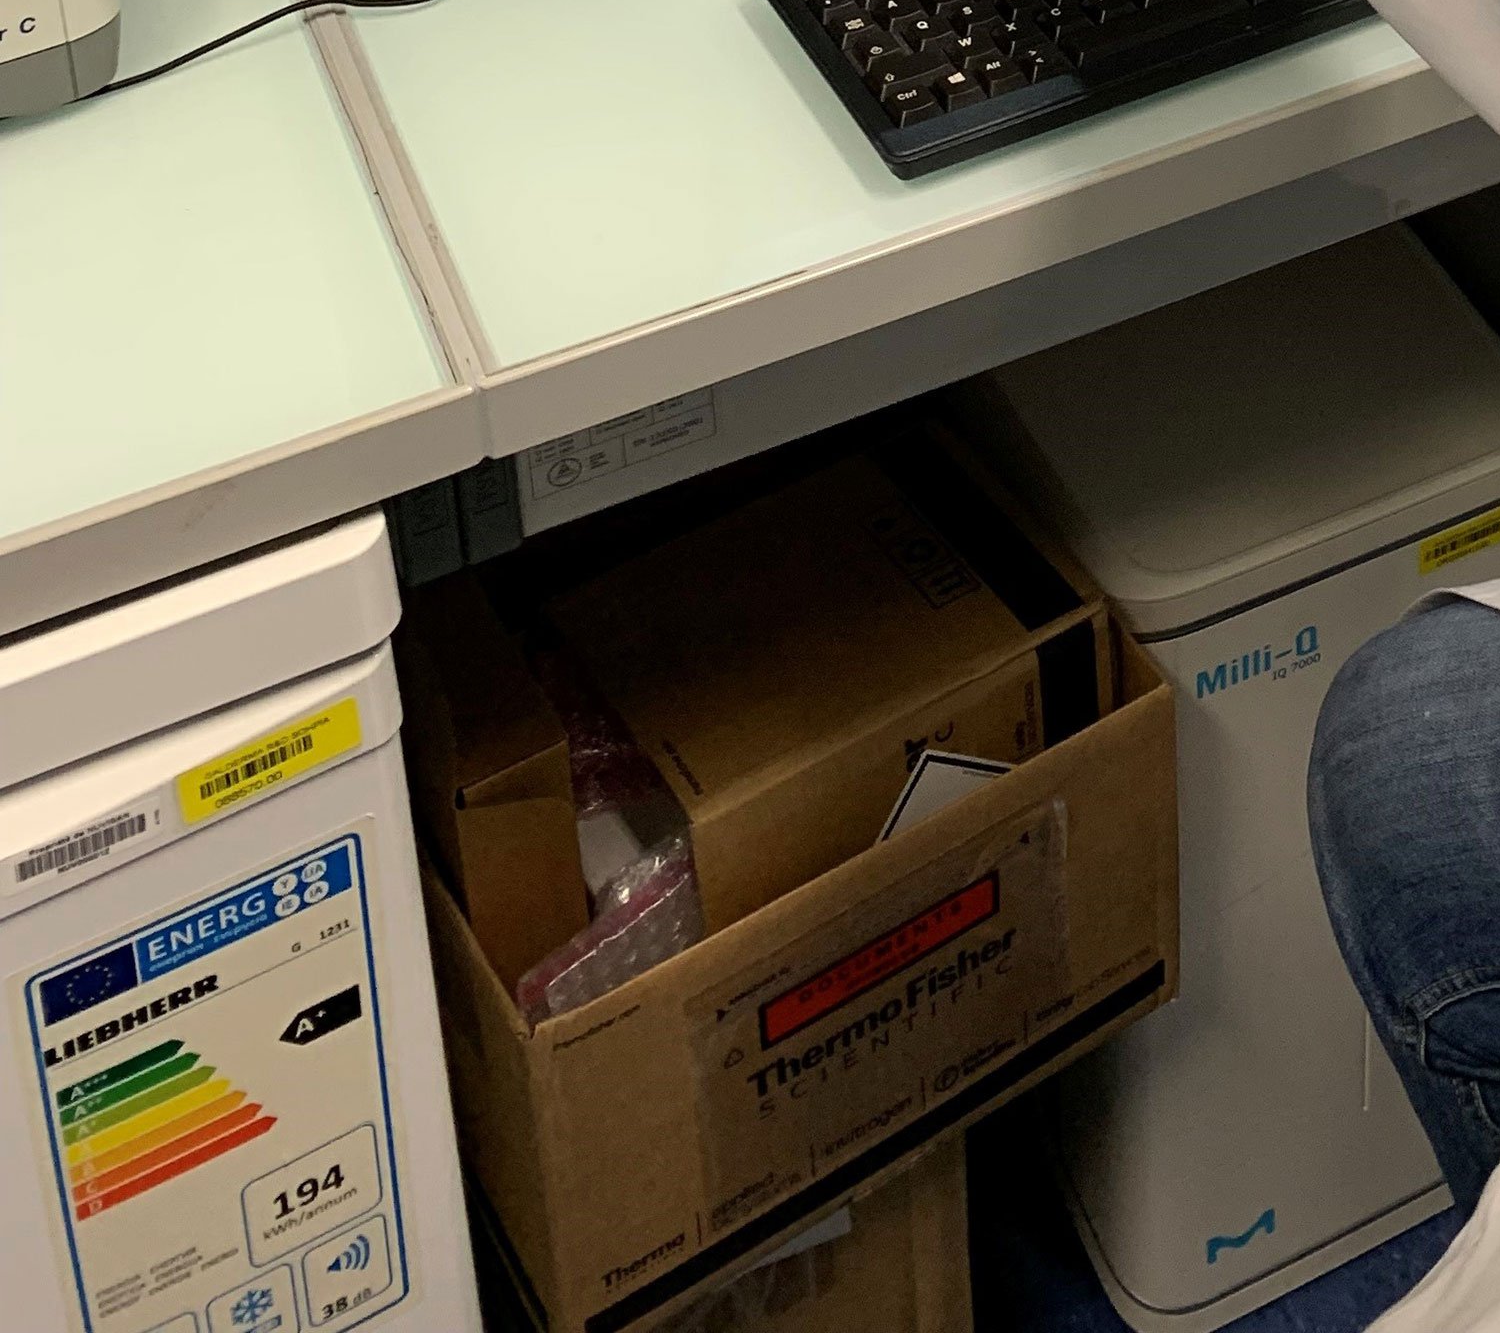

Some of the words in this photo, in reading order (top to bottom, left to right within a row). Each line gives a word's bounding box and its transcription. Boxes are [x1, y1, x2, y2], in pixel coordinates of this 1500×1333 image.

[887, 0, 899, 10] A
[19, 16, 36, 34] C
[916, 20, 930, 31] Q
[958, 37, 973, 48] W
[1004, 22, 1018, 33] X
[897, 89, 919, 102] Ctrl
[986, 60, 1002, 72] Alt
[1195, 624, 1320, 699] Milli-Q
[1291, 652, 1322, 673] 7000
[146, 891, 267, 963] ENERG
[291, 942, 302, 953] G
[319, 918, 351, 941] 1231
[44, 974, 220, 1068] LIEBHERR
[757, 957, 1013, 1119] SCIENTIFIC
[271, 1164, 347, 1220] 194
[262, 1185, 359, 1241] kWh/annum
[601, 1232, 686, 1289] Thermo
[320, 1296, 350, 1320] 38
